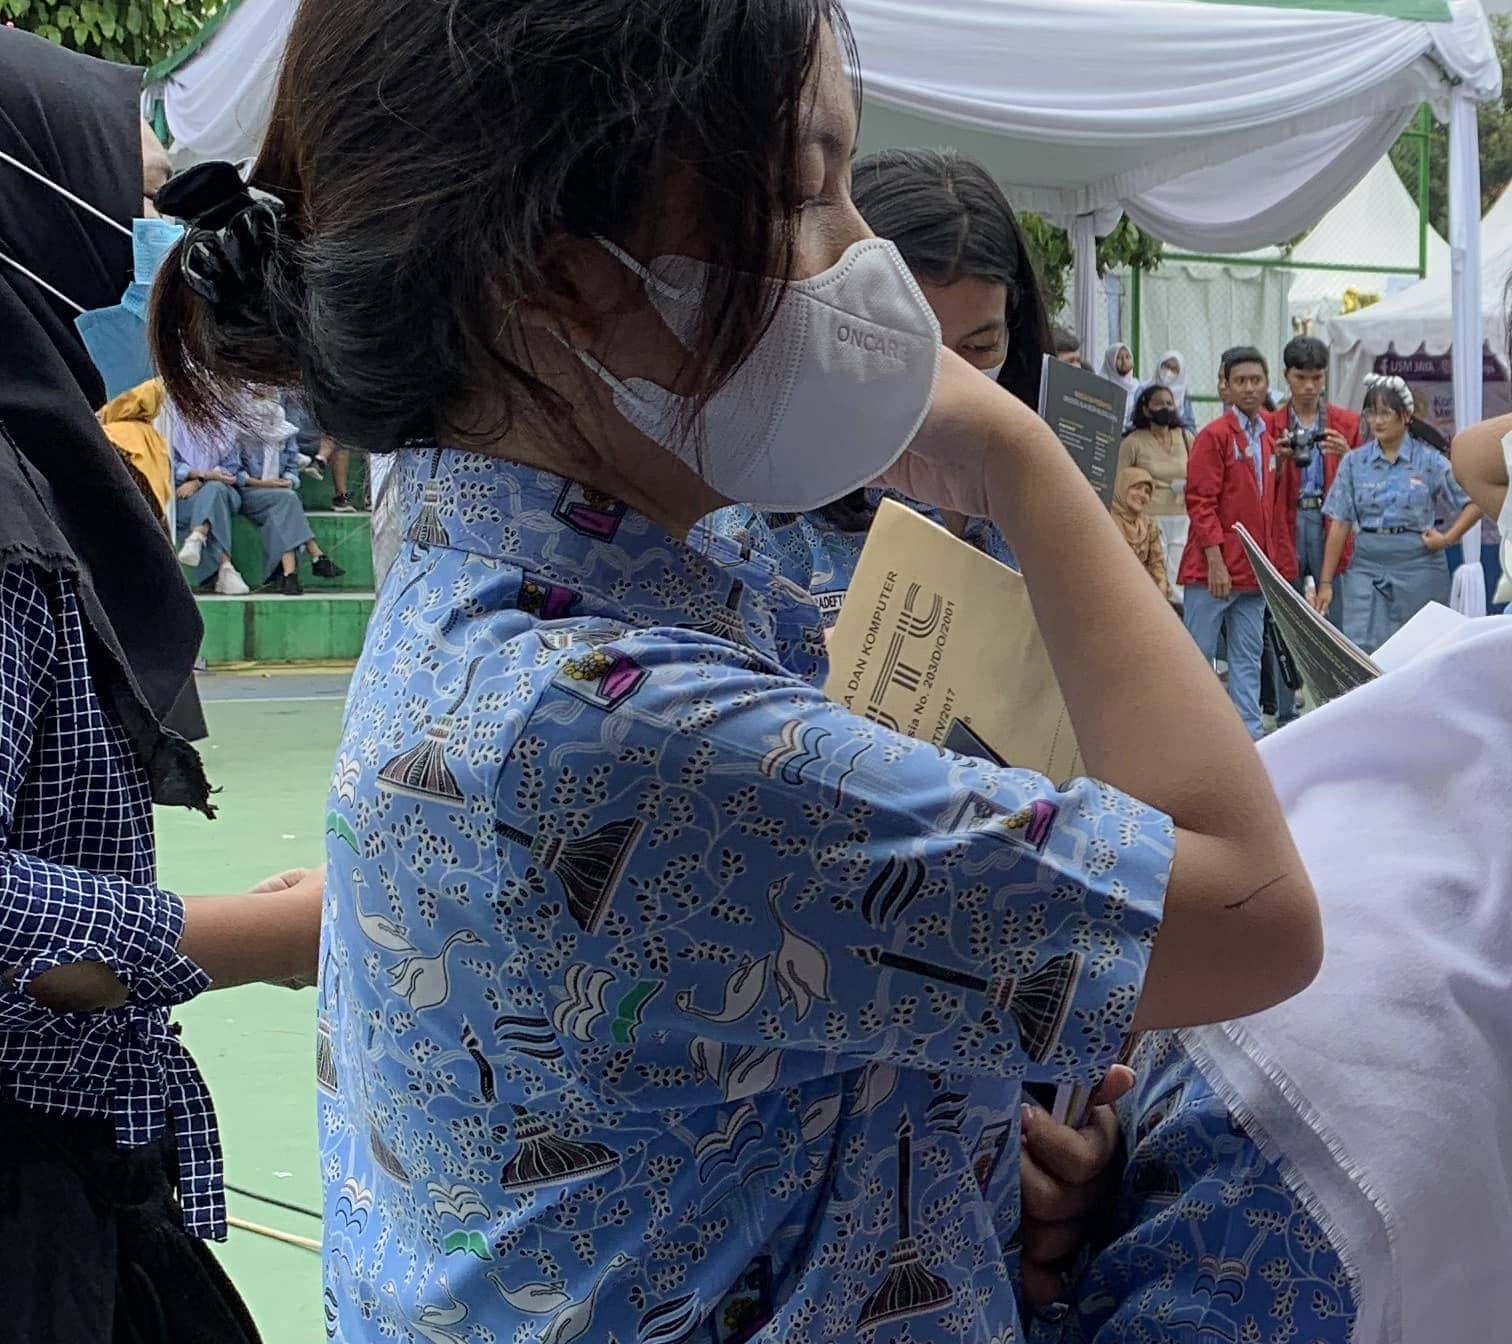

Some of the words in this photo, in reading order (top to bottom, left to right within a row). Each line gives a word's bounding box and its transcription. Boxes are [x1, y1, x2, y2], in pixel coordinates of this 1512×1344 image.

[848, 659, 867, 693] DAN
[862, 570, 898, 656] KOMPUTER
[914, 694, 929, 715] No.
[923, 600, 956, 689] 203/D/O/2001
